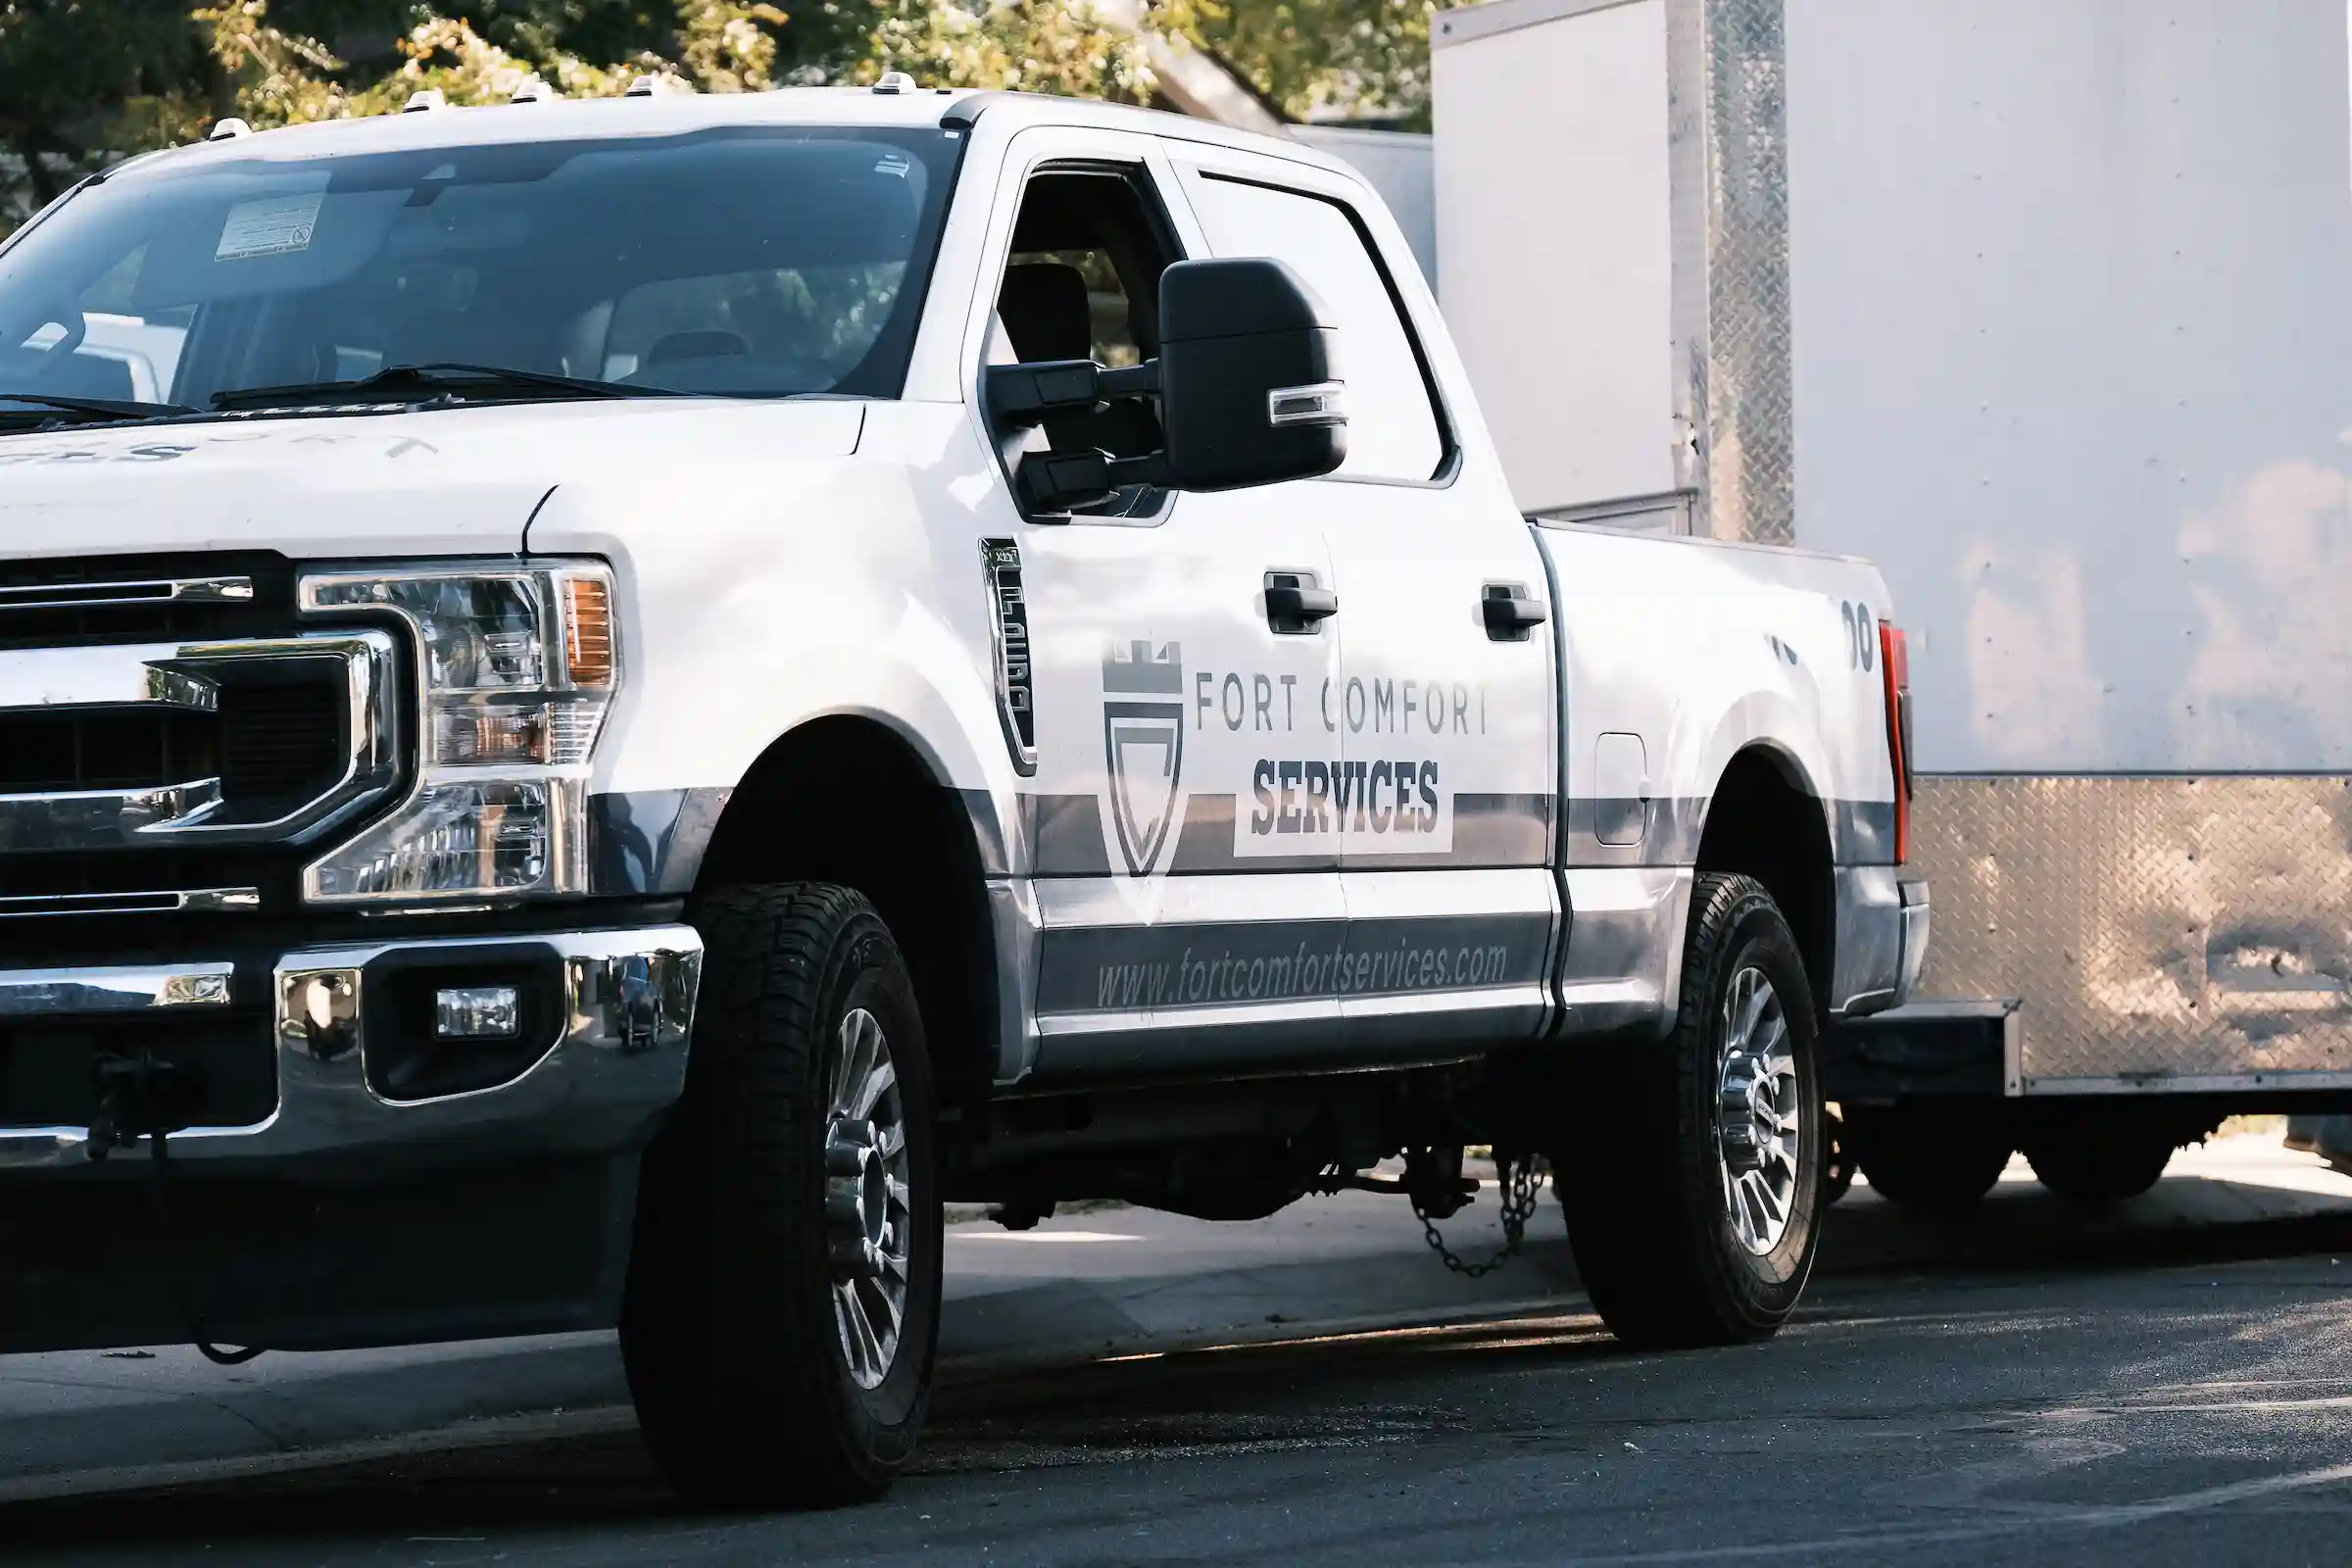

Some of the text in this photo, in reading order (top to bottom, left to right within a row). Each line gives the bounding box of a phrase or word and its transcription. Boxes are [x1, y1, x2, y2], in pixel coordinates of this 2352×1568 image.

[1195, 671, 1490, 735] FORT COMFORT
[1250, 758, 1439, 837] SERVICES
[1097, 936, 1509, 1008] www.fortcomfortservices.com
